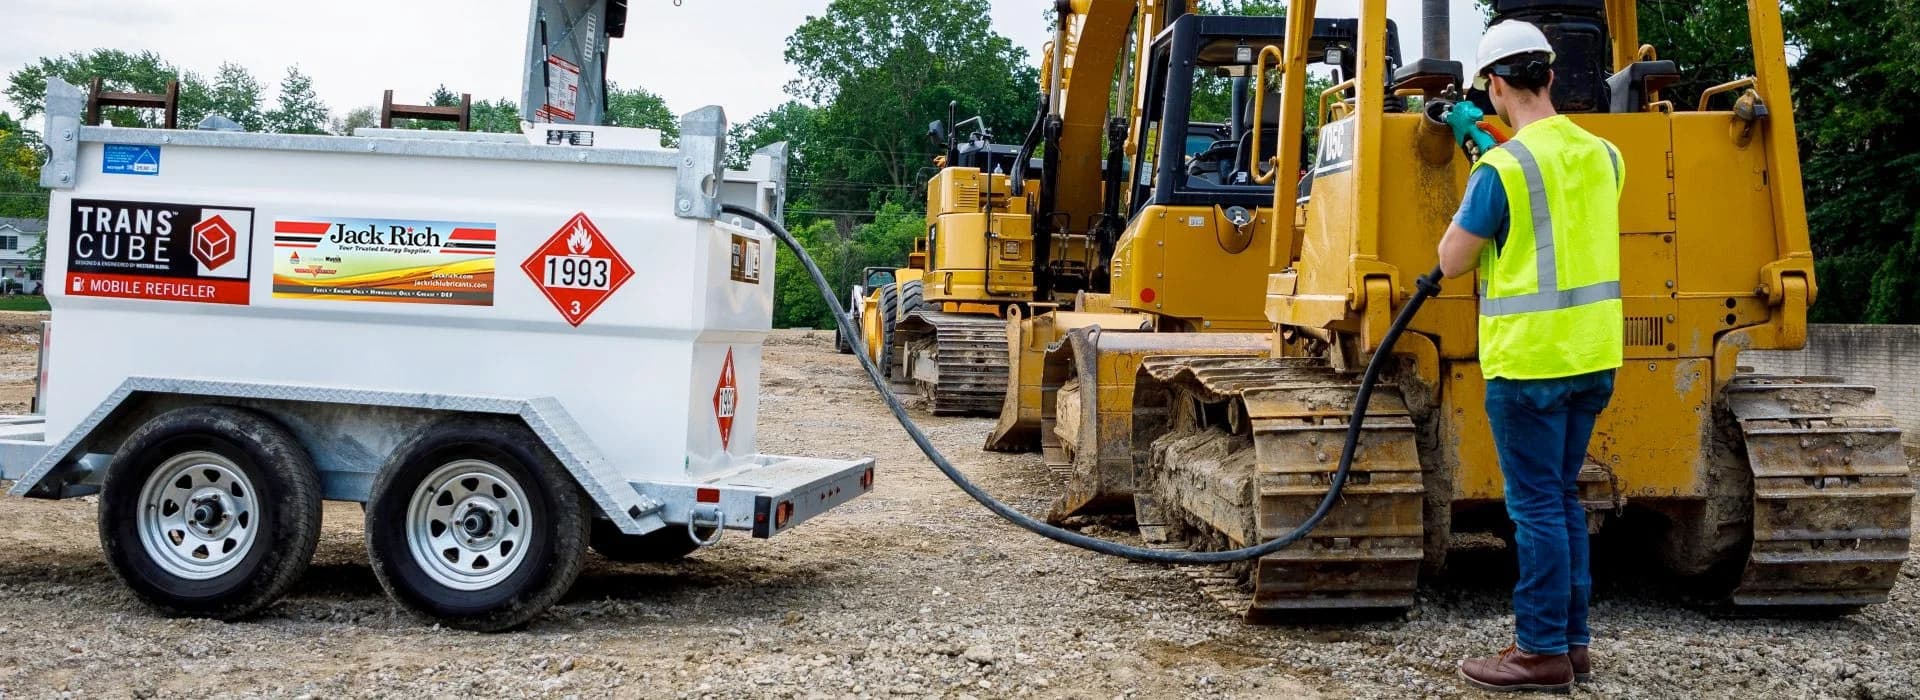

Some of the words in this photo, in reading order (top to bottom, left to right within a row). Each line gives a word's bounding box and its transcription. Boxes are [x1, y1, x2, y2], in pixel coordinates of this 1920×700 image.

[1326, 124, 1345, 162] D5C
[330, 223, 384, 246] Jack
[389, 225, 441, 248] Rich
[76, 233, 171, 263] CUBE
[380, 246, 402, 254] Energy
[548, 257, 608, 288] 1993
[90, 279, 141, 294] MOBILE
[145, 282, 216, 298] REFUELER
[414, 280, 488, 289] jackrichlubricants.com
[570, 300, 581, 315] 3
